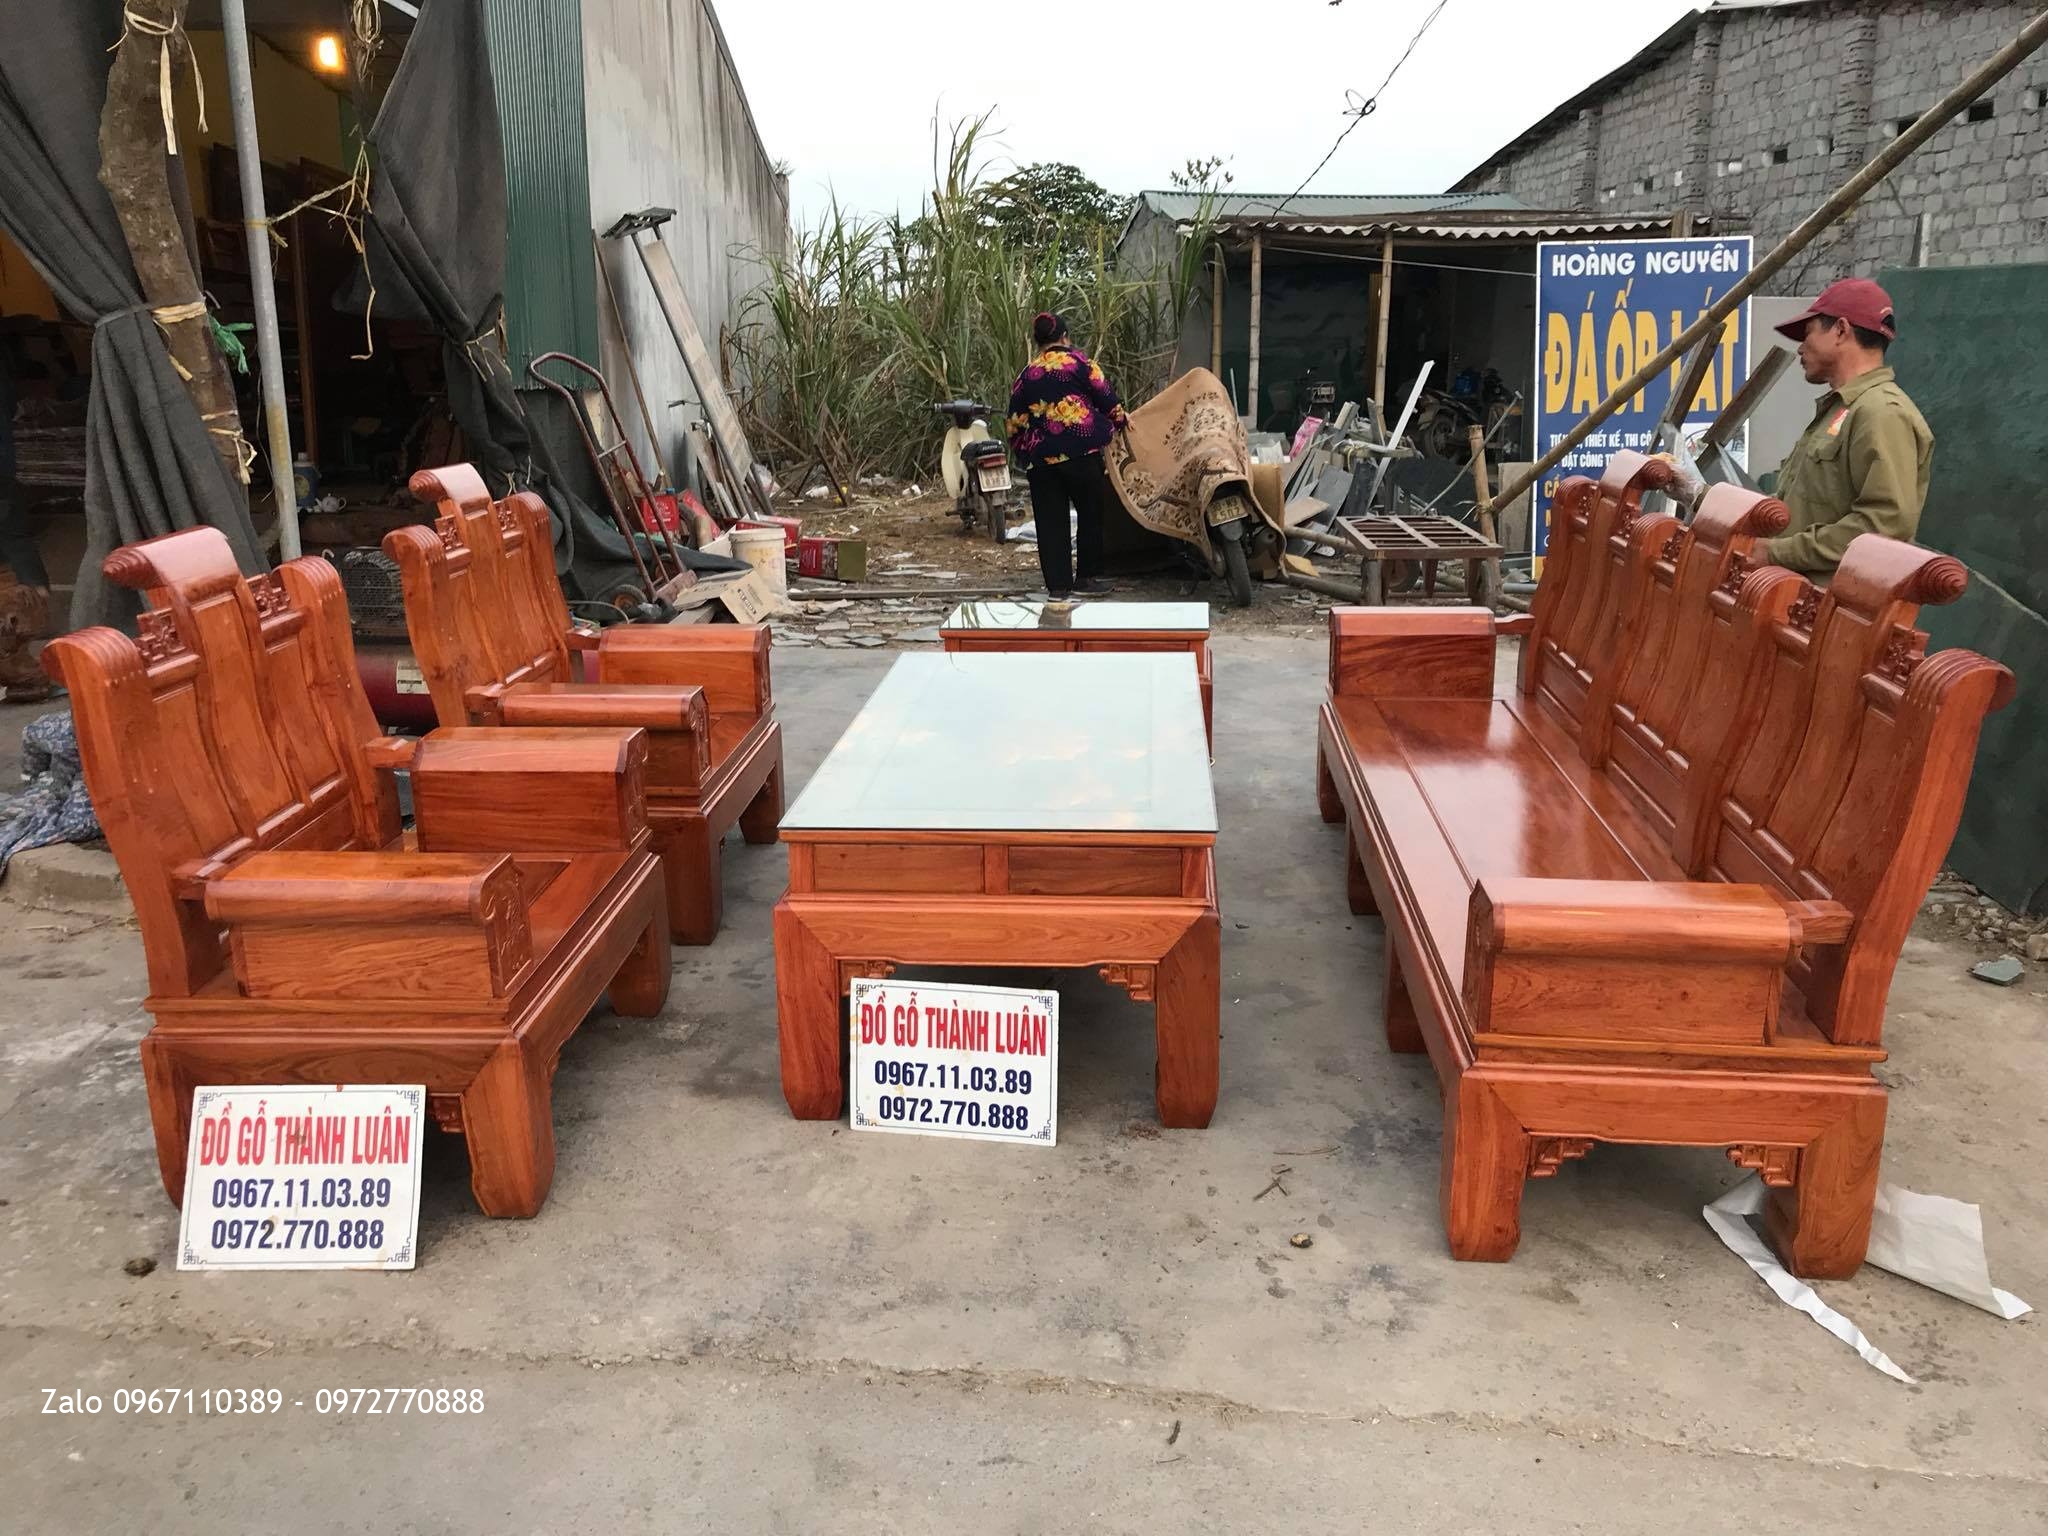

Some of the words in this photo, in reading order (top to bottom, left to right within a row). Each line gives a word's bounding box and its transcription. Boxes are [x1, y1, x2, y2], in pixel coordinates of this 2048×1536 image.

[1552, 246, 1636, 277] HOÀNG
[1645, 243, 1739, 275] NGUYÊN
[1544, 290, 1600, 414] ĐÁ
[1606, 278, 1659, 416] ỐP
[1584, 429, 1607, 447] THIẾT
[1624, 432, 1639, 447] THI
[1579, 451, 1604, 468] CÔNG
[861, 991, 887, 1045] ĐỒ
[893, 991, 918, 1047] GỖ
[925, 1000, 989, 1052] THÀNH
[995, 1005, 1047, 1057] LUÂN
[874, 1060, 1032, 1095] 0967.11.03.89
[879, 1095, 1029, 1131] 0972.770.888
[200, 1101, 232, 1166] ĐỒ
[236, 1100, 267, 1166] GỖ
[274, 1106, 347, 1165] THÀNH
[352, 1105, 411, 1165] LUÂN
[212, 1178, 392, 1208] 0967.11.03.89
[211, 1219, 385, 1249] 0972.770.888
